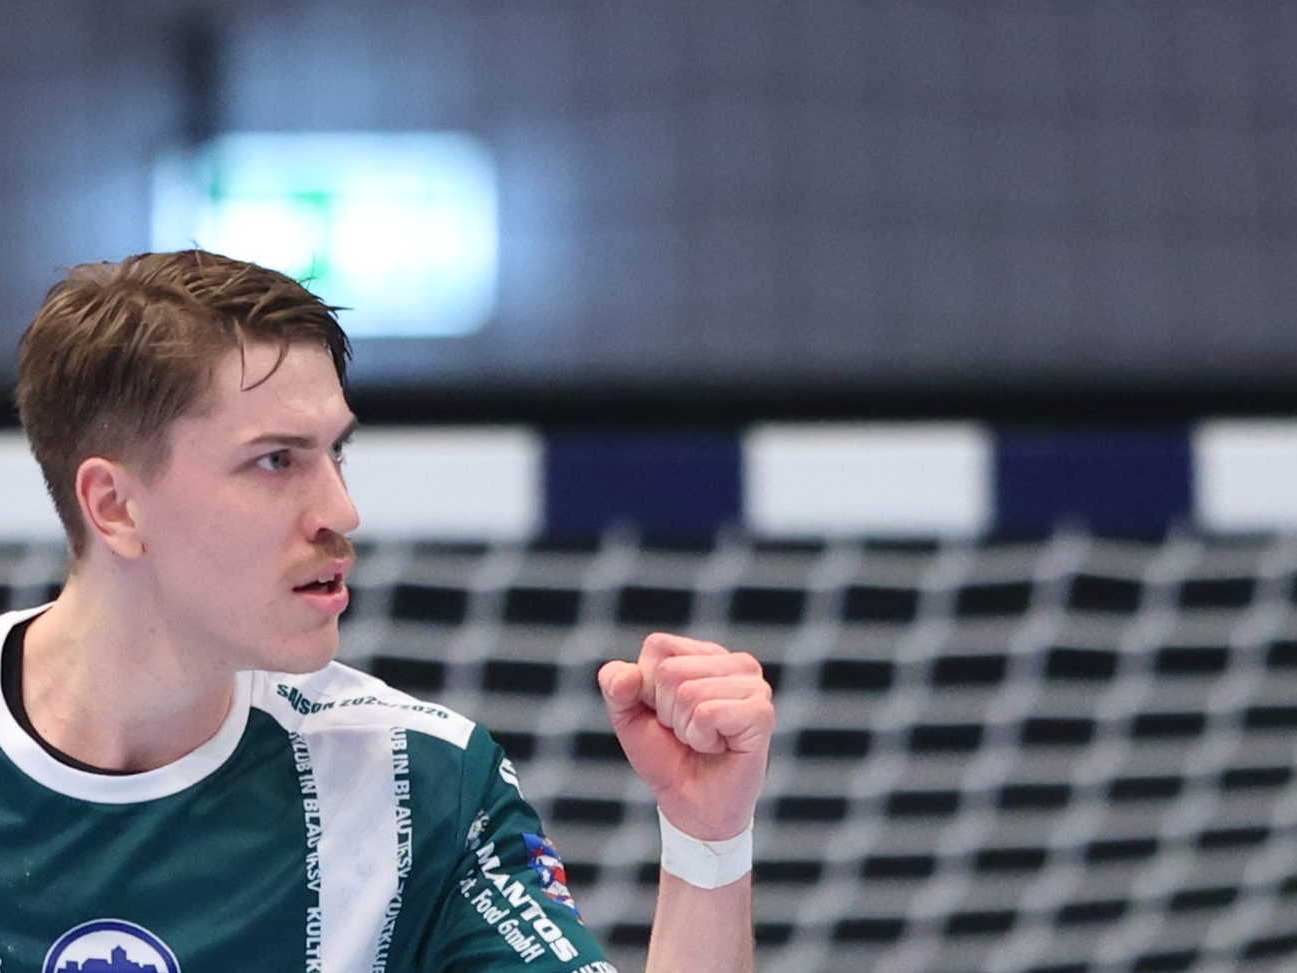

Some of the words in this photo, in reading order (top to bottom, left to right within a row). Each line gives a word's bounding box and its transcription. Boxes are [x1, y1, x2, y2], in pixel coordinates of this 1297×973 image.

[299, 775, 317, 794] IN
[393, 754, 409, 774] IN
[304, 799, 322, 849] BLAU
[395, 780, 412, 834] BLAU
[471, 888, 510, 926] Food
[498, 918, 546, 964] GmbH
[476, 842, 579, 962] MANTOS
